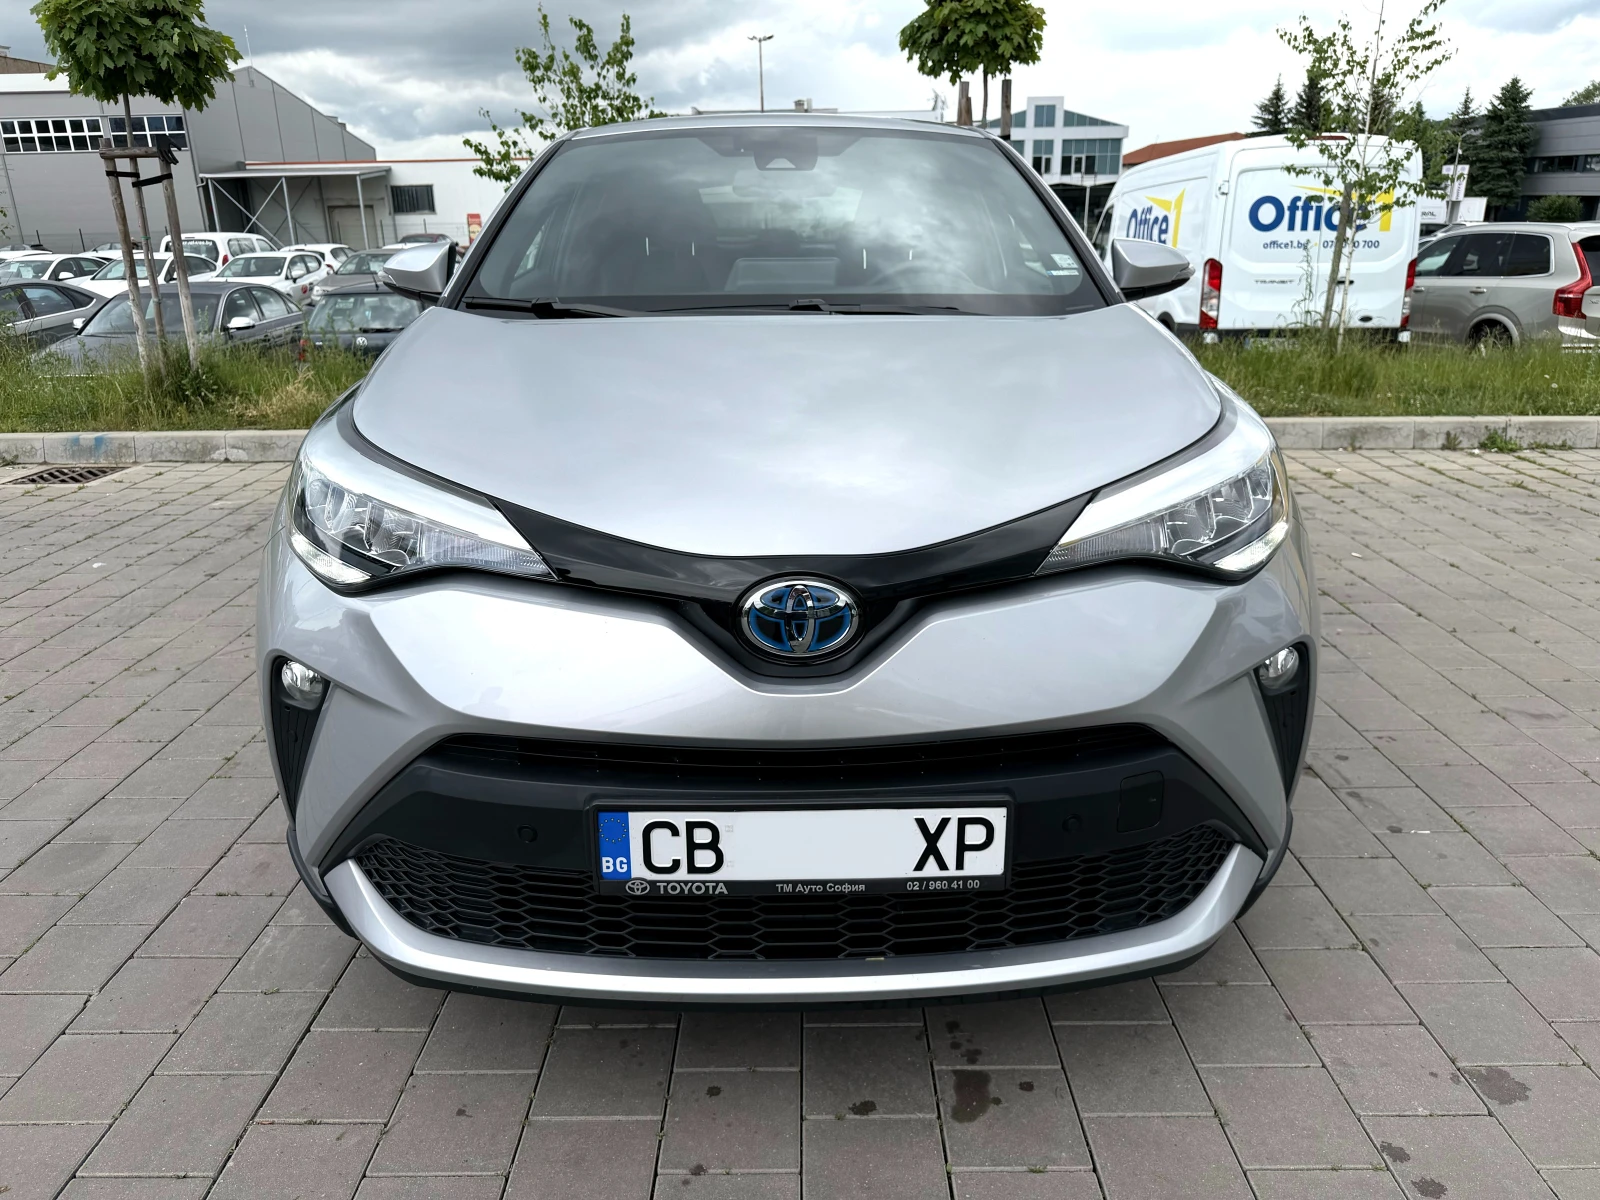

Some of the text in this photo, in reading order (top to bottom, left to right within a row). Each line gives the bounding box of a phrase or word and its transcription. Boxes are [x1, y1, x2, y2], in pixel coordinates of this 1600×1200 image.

[1362, 240, 1380, 249] 700
[641, 816, 996, 875] CB XP
[601, 856, 628, 874] BG
[656, 882, 729, 895] TOYOTA
[795, 884, 823, 894] Ауто
[826, 883, 866, 894] София
[906, 881, 920, 891] 02
[928, 880, 948, 890] 960
[950, 880, 964, 889] 41
[966, 879, 980, 889] 00
